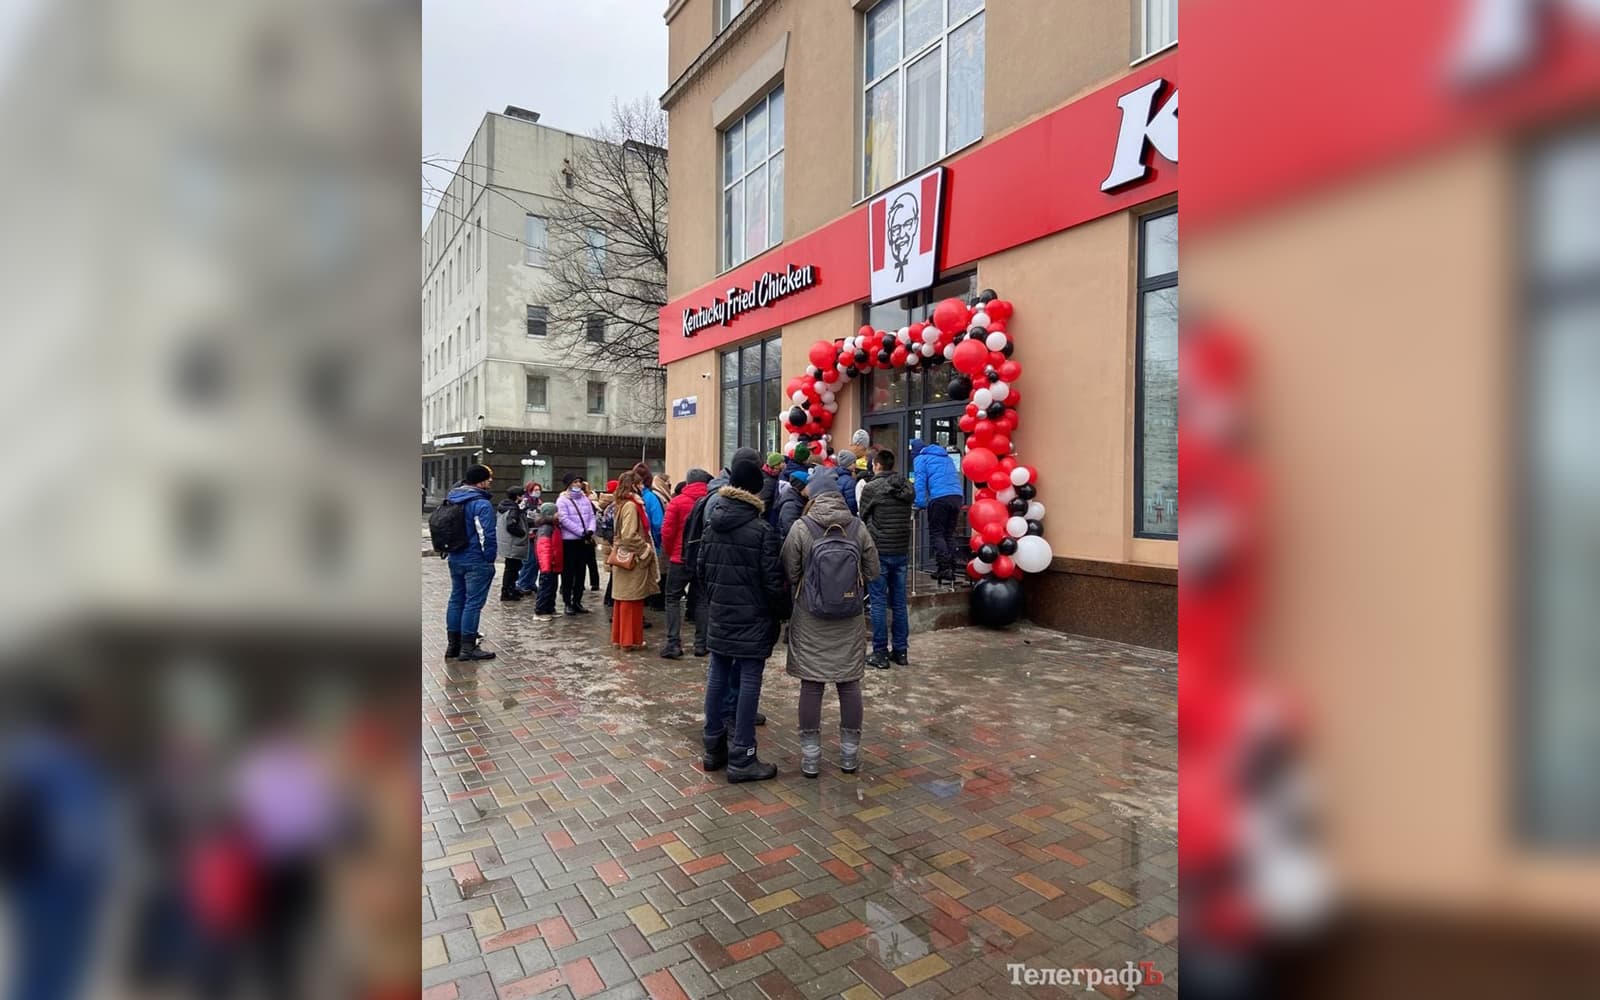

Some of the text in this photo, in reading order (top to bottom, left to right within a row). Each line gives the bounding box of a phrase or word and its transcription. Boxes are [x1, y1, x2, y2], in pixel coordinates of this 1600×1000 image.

[1100, 78, 1178, 192] K
[682, 263, 813, 338] Kentucky Fried Chicken
